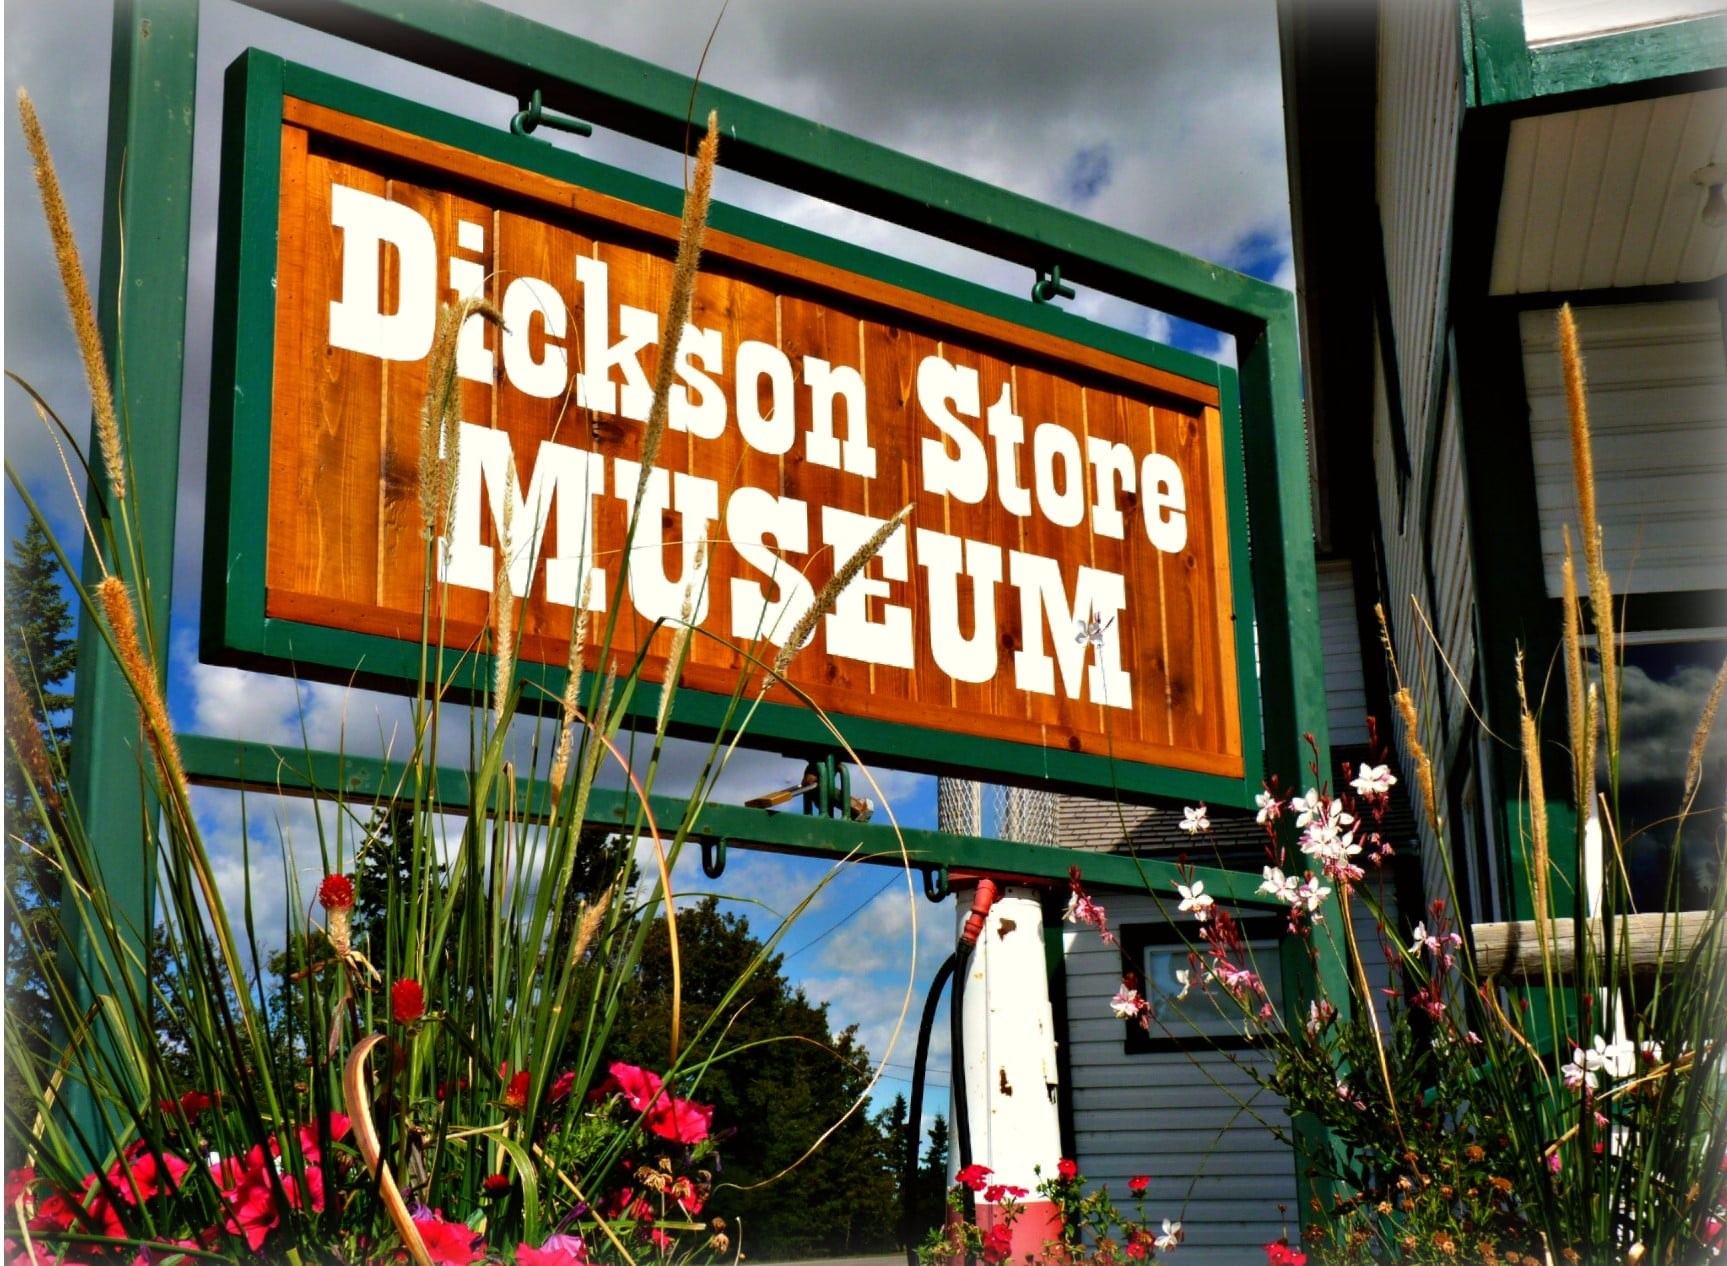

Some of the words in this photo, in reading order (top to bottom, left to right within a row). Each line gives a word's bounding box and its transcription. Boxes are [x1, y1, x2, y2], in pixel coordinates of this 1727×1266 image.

[328, 183, 876, 478] Dickson
[917, 355, 1188, 554] Store
[437, 420, 1132, 709] MUSEUM
